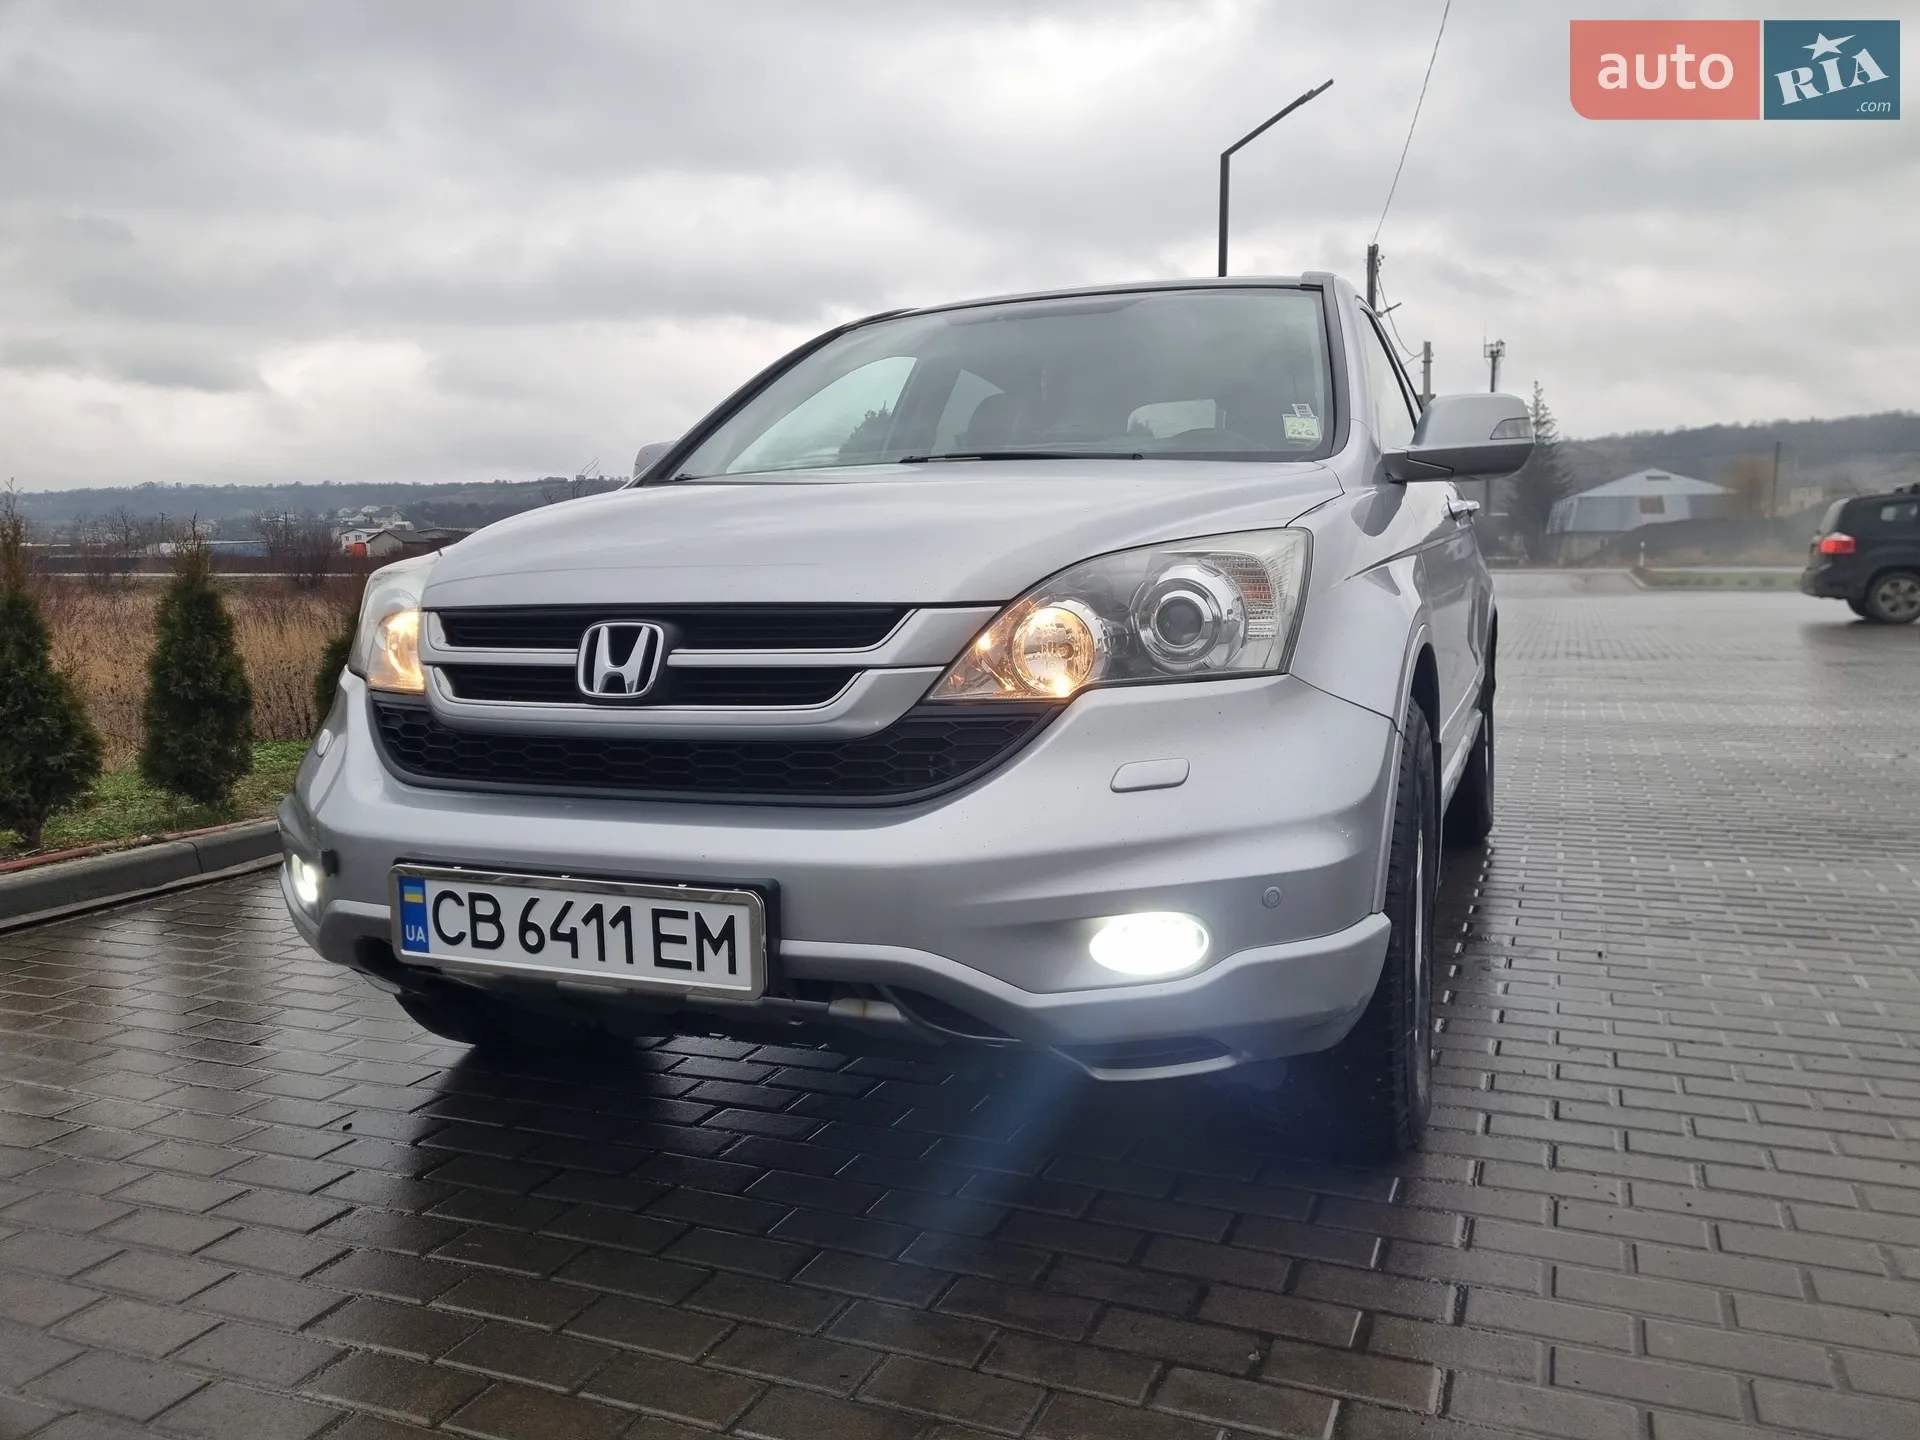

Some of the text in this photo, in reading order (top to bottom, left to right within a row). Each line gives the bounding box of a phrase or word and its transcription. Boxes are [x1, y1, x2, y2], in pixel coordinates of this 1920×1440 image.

[405, 924, 426, 943] UA
[432, 889, 737, 975] CB 6411 EM
